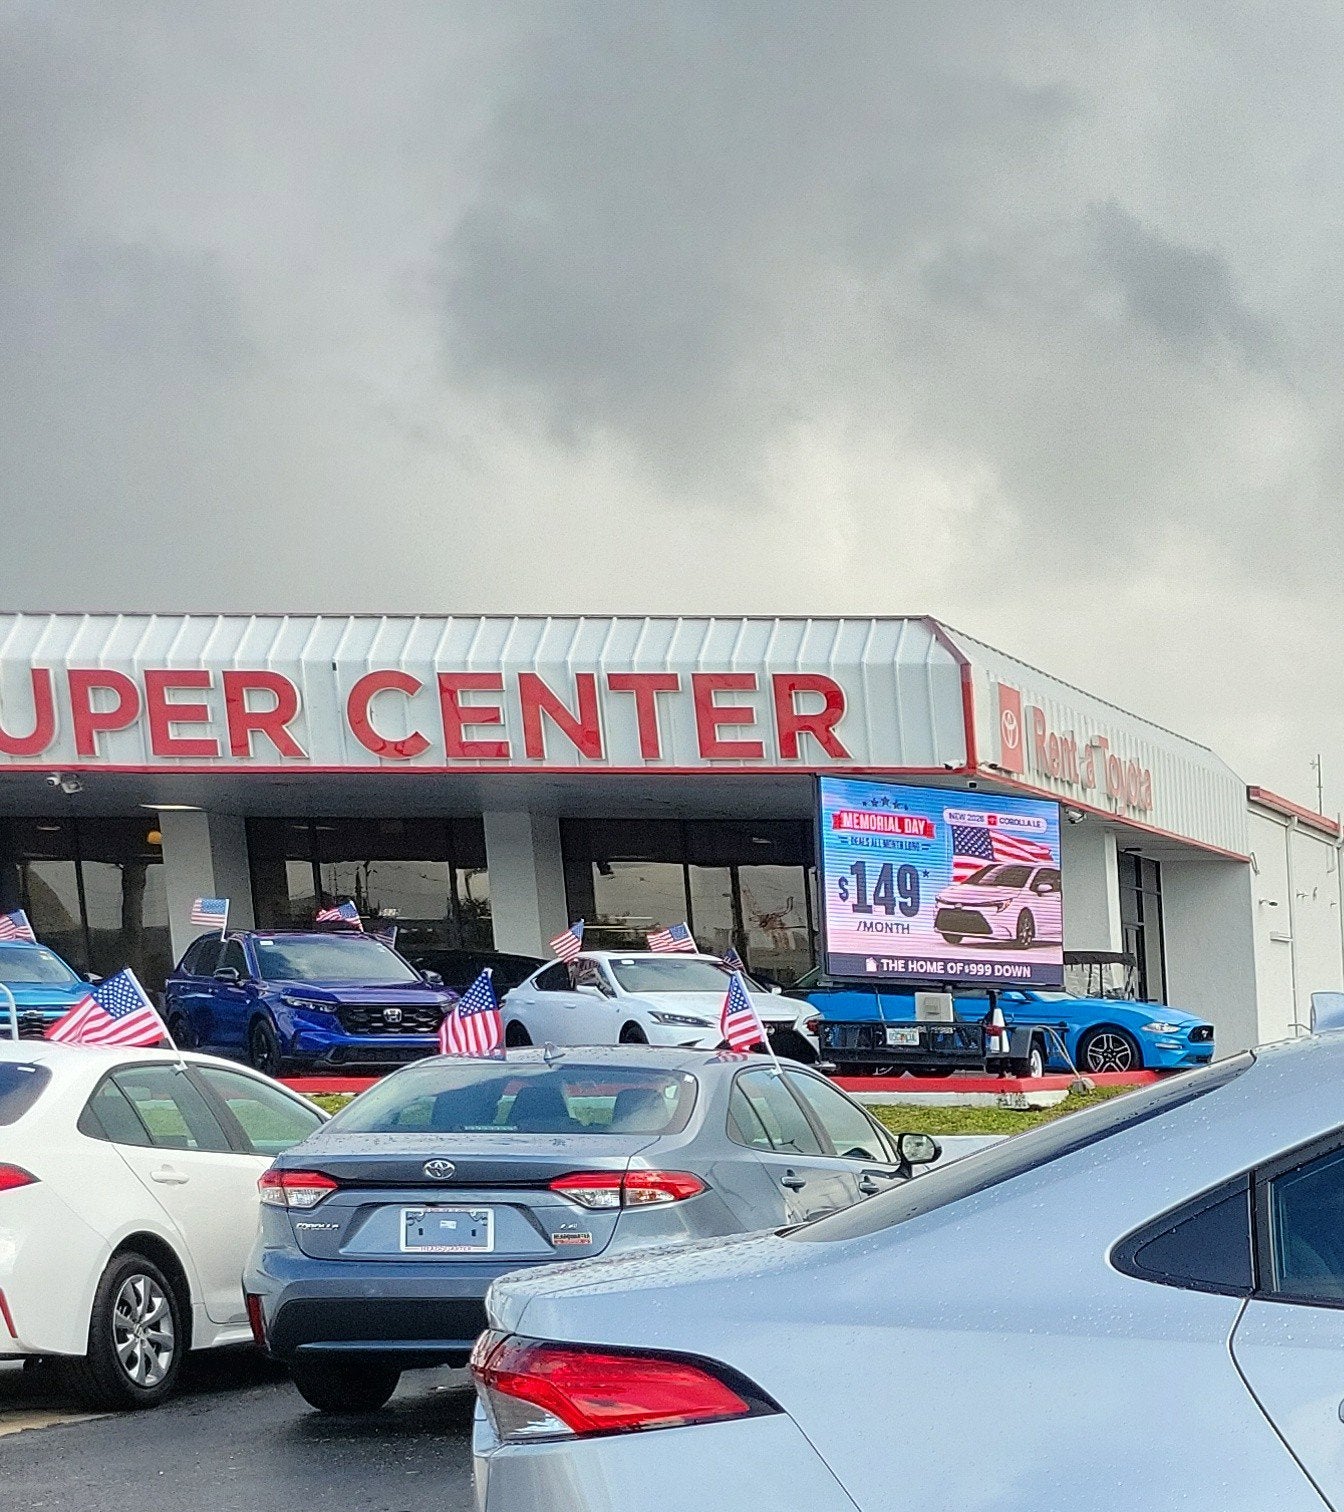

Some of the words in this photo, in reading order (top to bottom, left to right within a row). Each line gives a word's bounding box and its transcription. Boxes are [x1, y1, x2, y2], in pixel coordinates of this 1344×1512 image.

[346, 669, 853, 761] CENTER
[1025, 705, 1079, 784] Rent
[1091, 735, 1153, 816] Toyota
[841, 812, 902, 833] MEMORIAL
[903, 818, 926, 835] DAY
[857, 921, 910, 934] /MONTH
[881, 959, 905, 972] THE
[908, 961, 945, 974] HOME
[947, 963, 964, 974] OF
[994, 965, 1031, 978] DOWN
